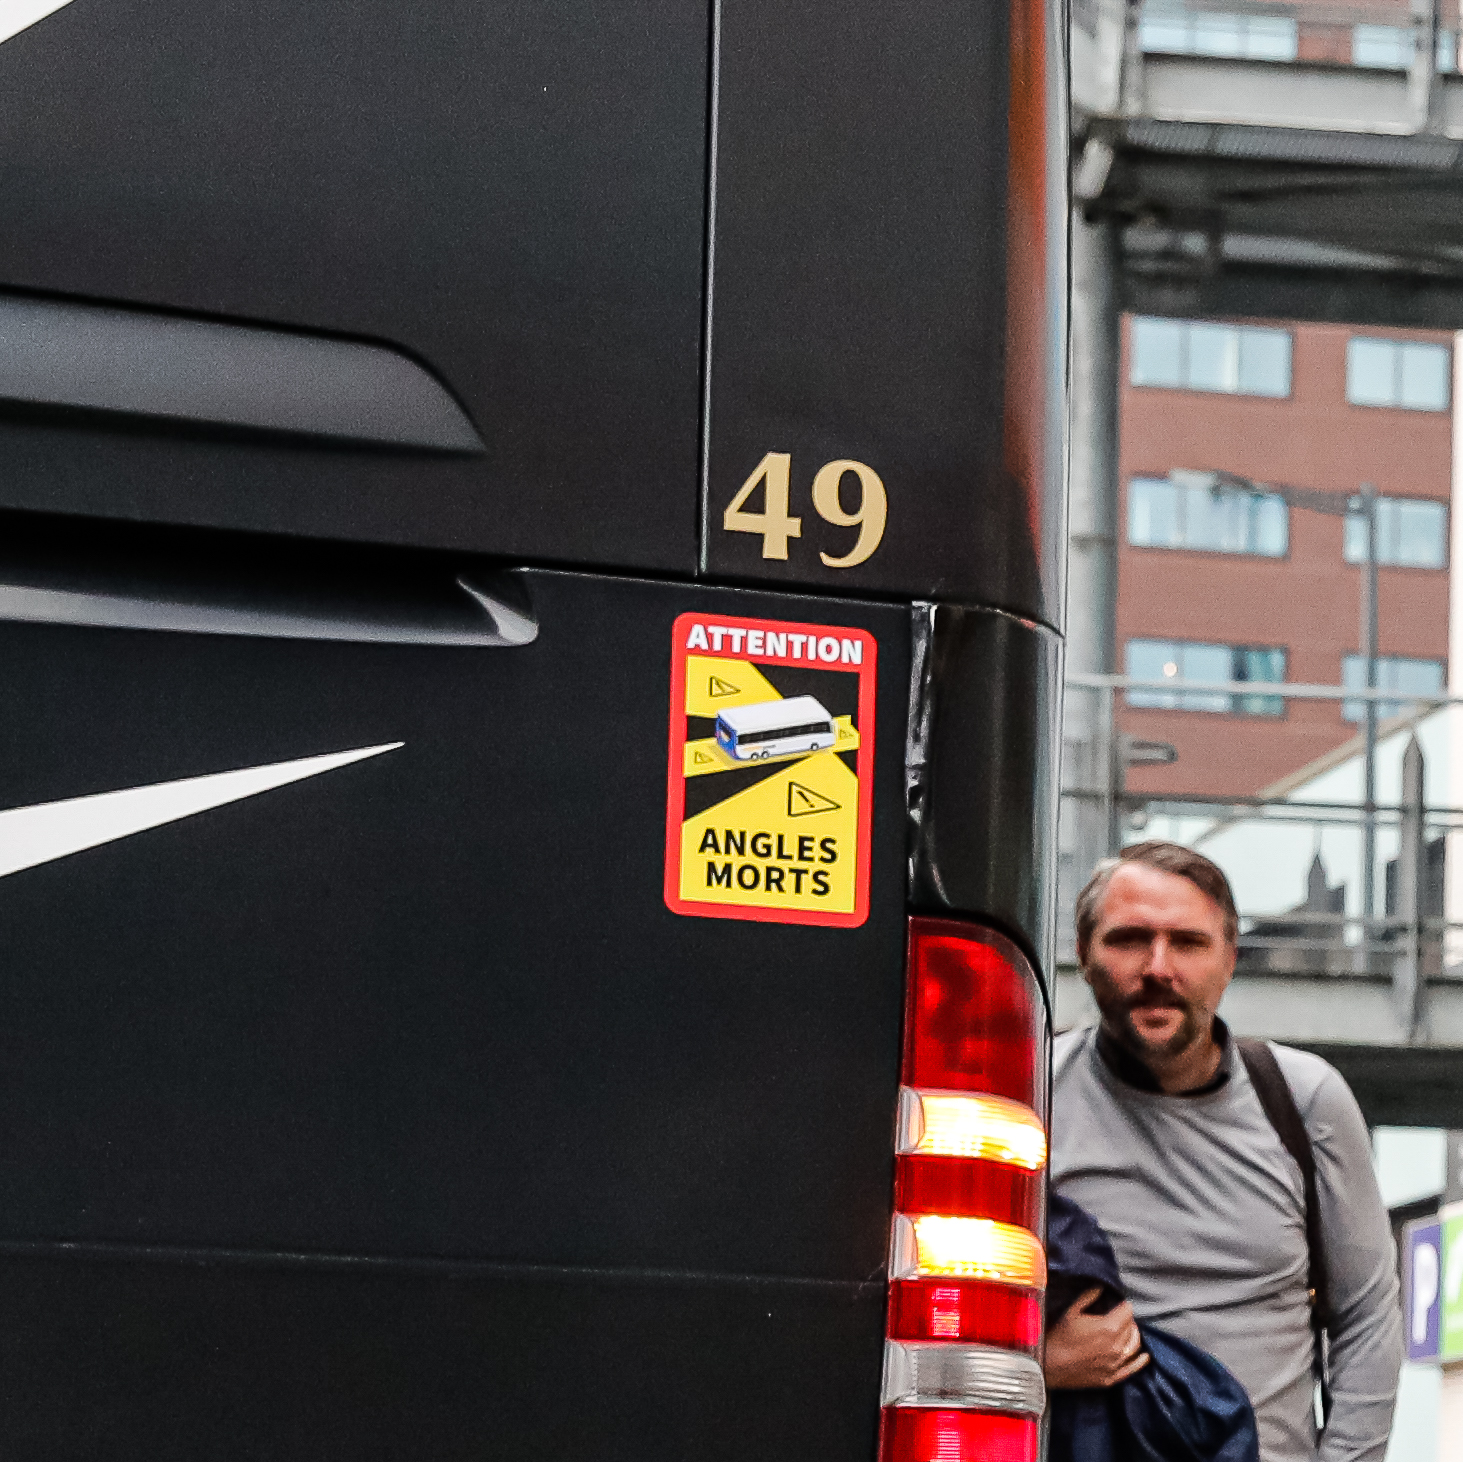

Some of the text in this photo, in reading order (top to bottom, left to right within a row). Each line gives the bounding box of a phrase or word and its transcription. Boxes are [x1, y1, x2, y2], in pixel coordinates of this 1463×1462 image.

[723, 452, 887, 568] 49
[686, 623, 863, 665] ATTENTION
[698, 827, 839, 864] ANGLES
[705, 861, 831, 896] MORTS
